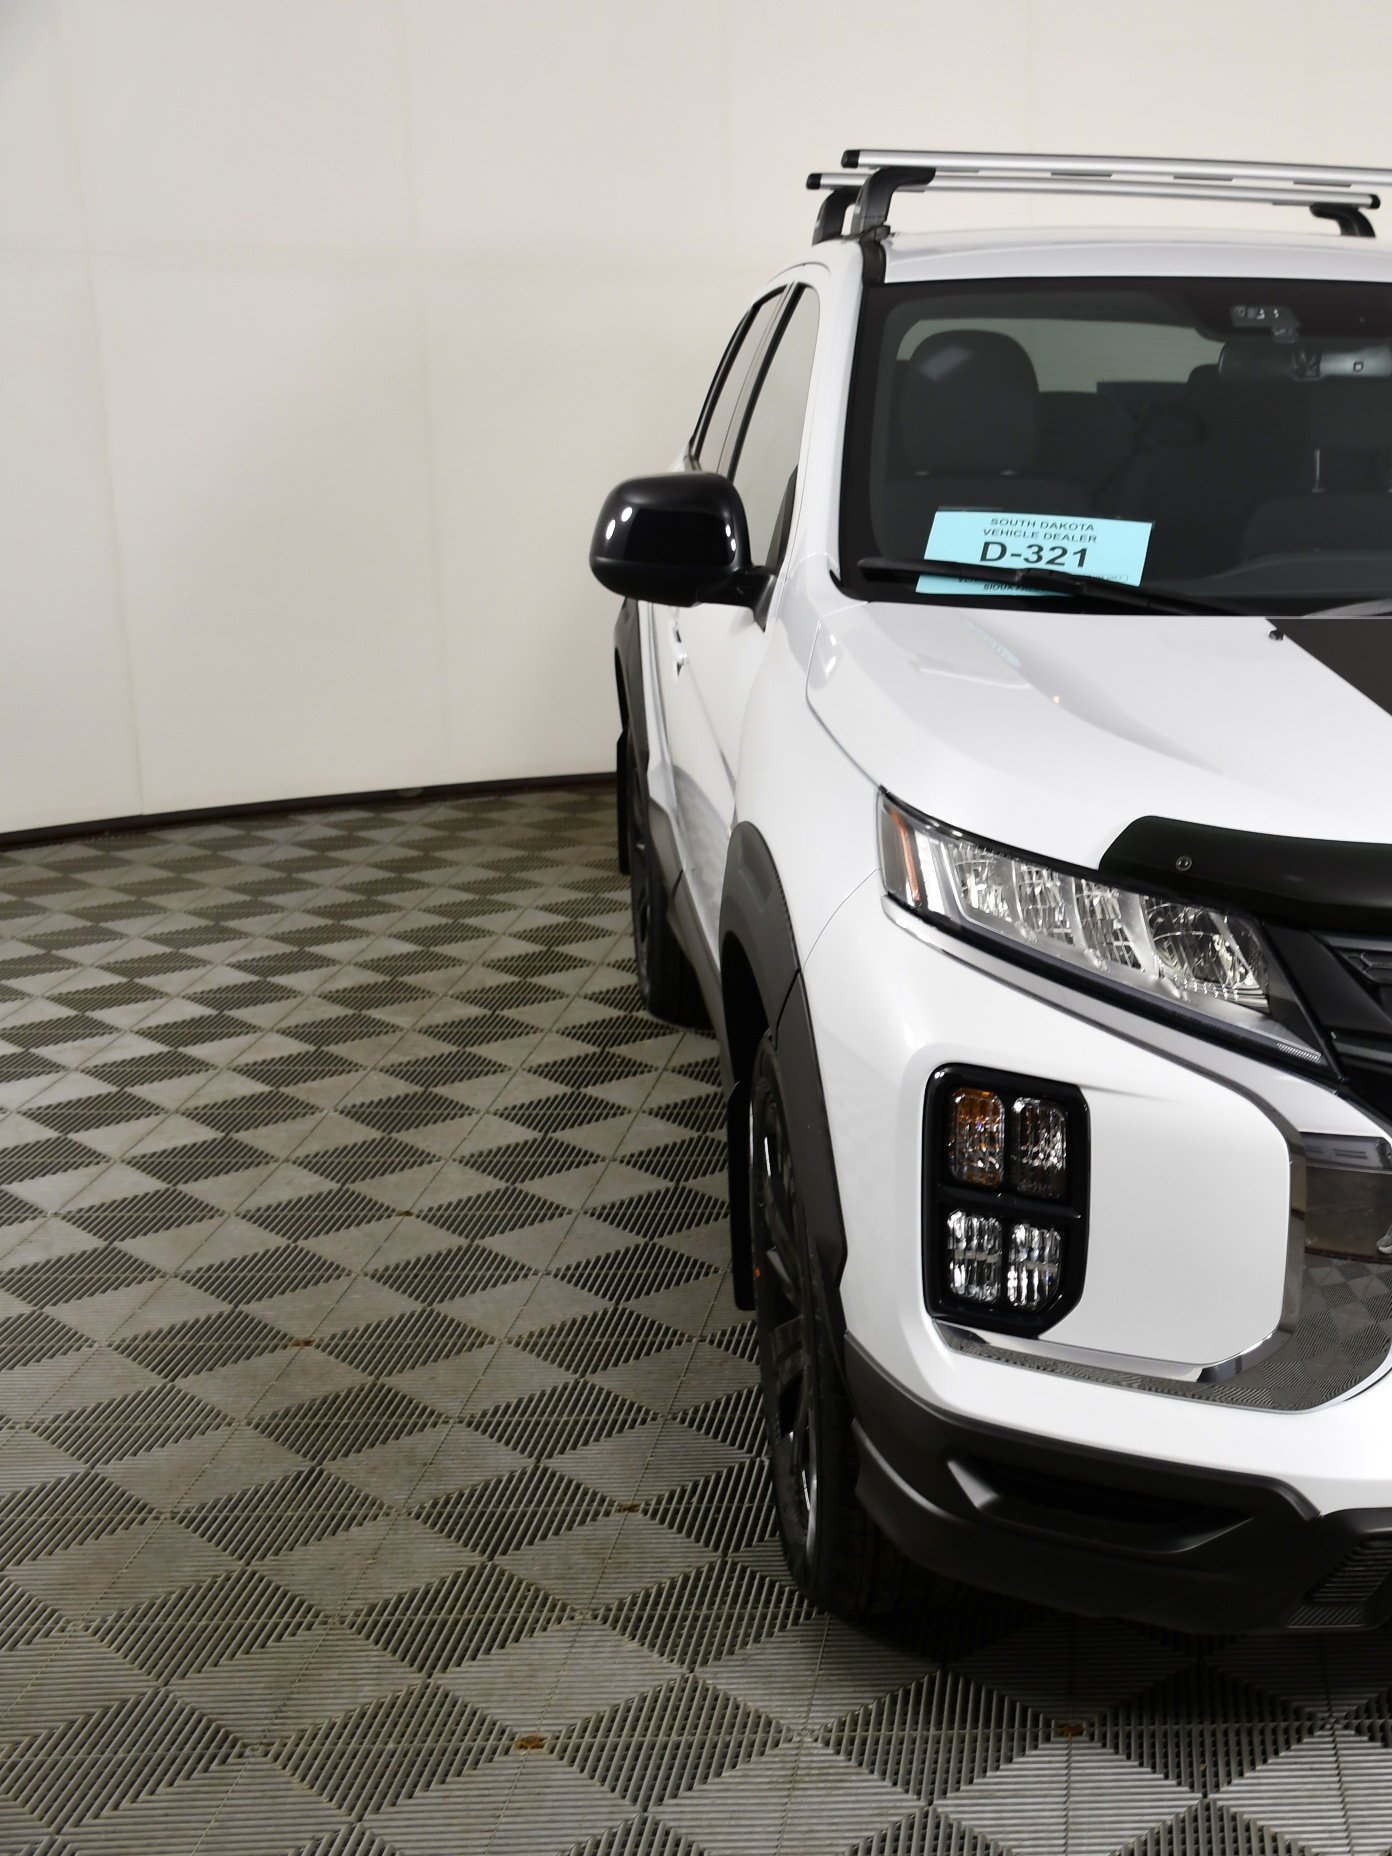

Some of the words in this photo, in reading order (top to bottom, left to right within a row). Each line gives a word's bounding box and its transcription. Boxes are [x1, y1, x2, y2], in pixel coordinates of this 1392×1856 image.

[991, 518, 1036, 528] SOUTH
[1040, 521, 1094, 531] DAKOTA
[983, 528, 1039, 538] VEHICLE
[1044, 532, 1098, 543] DEALER
[980, 541, 1088, 568] D-321
